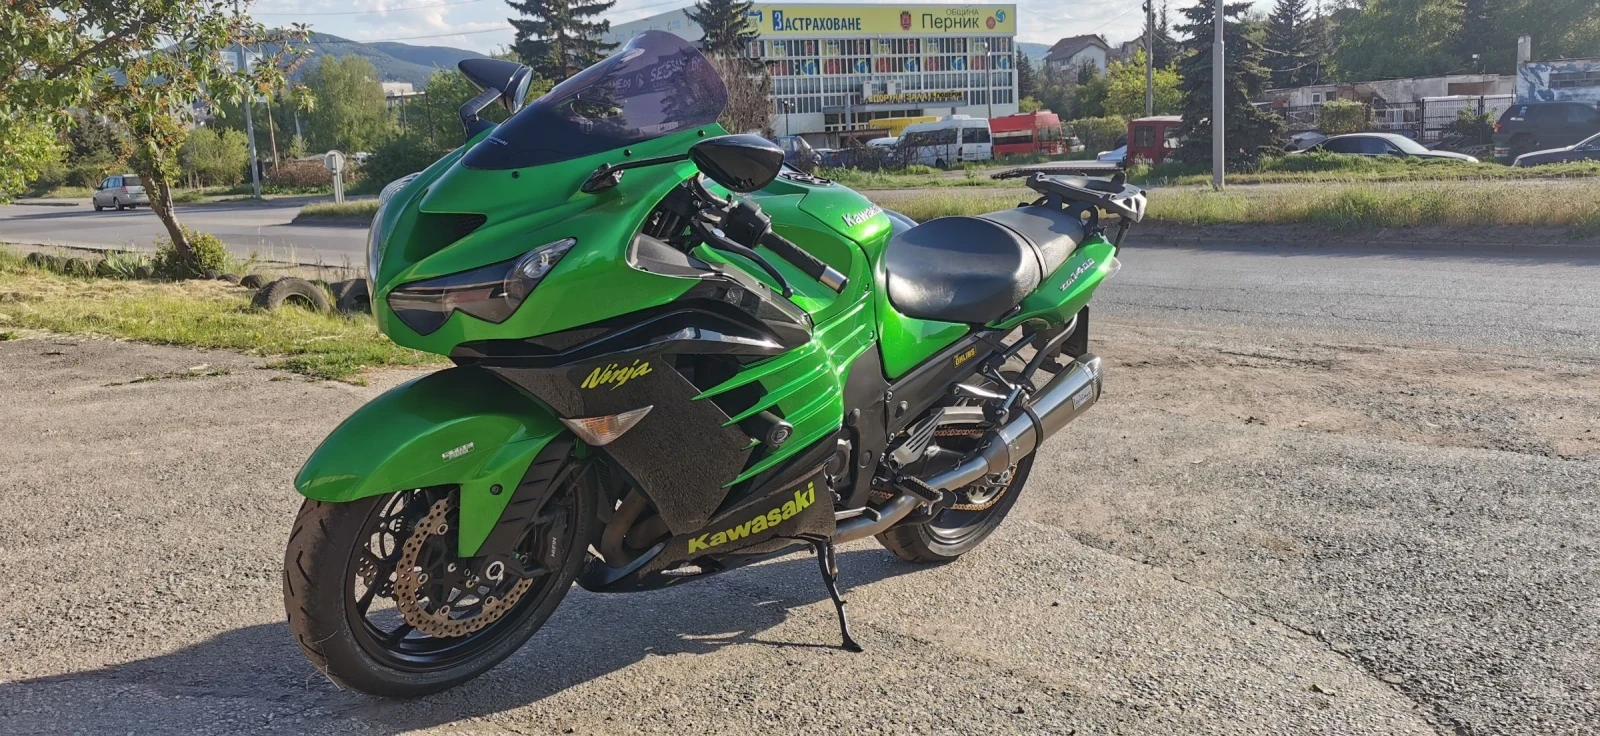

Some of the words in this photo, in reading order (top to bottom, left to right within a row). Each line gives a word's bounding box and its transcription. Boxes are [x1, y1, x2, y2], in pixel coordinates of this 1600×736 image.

[773, 11, 861, 31] ЗАСТРАХОВАНЕ
[922, 13, 980, 32] Перник
[945, 8, 979, 17] ОБЩИНА
[581, 359, 652, 391] Ninja
[688, 482, 815, 554] Kawasaki
